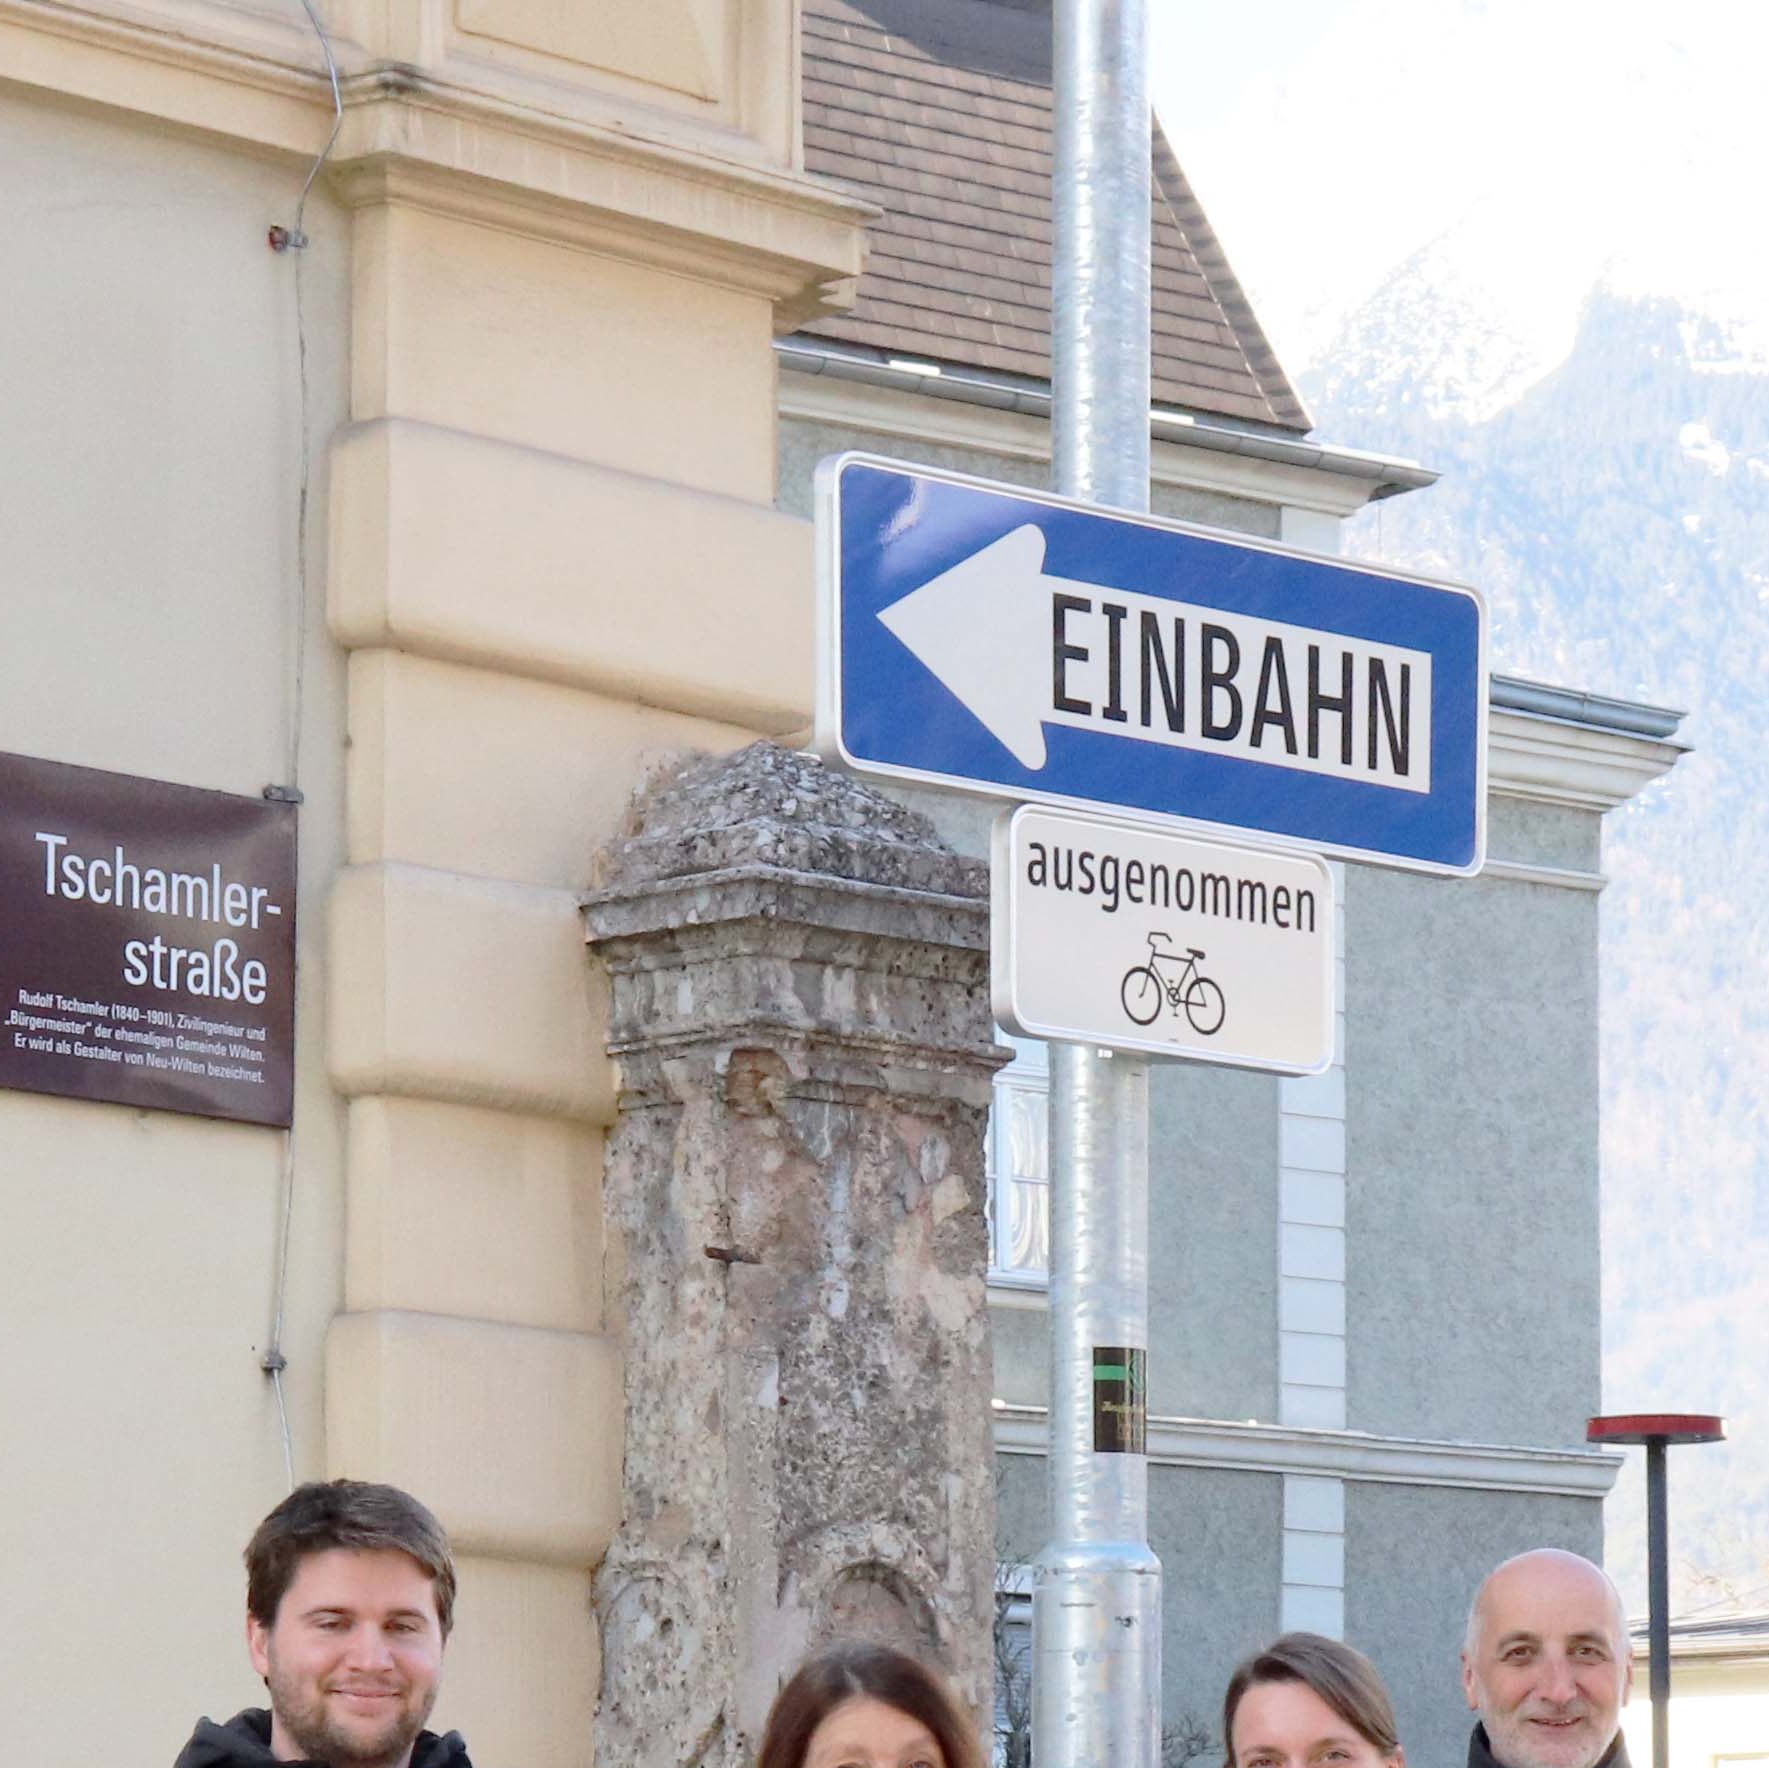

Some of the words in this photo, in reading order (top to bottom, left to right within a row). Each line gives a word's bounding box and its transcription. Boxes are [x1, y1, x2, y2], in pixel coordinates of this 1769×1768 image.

[1051, 593, 1411, 778] EINBAHN
[35, 831, 281, 929] Tschamler-
[1027, 841, 1315, 933] ausgenommen
[123, 935, 267, 1004] straße
[18, 989, 54, 1009] Rudolf
[55, 995, 110, 1017] Tschamler
[176, 1013, 245, 1037] Zivilingenieur
[246, 1027, 266, 1041] und
[94, 1023, 113, 1039] der
[114, 1027, 174, 1050] ehemaligen
[176, 1035, 227, 1057] Gemeinde
[228, 1043, 265, 1062] Wilten.
[14, 1032, 27, 1048] Er
[28, 1036, 54, 1052] wird
[55, 1040, 72, 1055] als
[74, 1041, 123, 1062] Gestalter
[124, 1052, 144, 1066] von
[146, 1052, 205, 1075] Neu-Wilten
[207, 1061, 265, 1084] bezeichnet.
